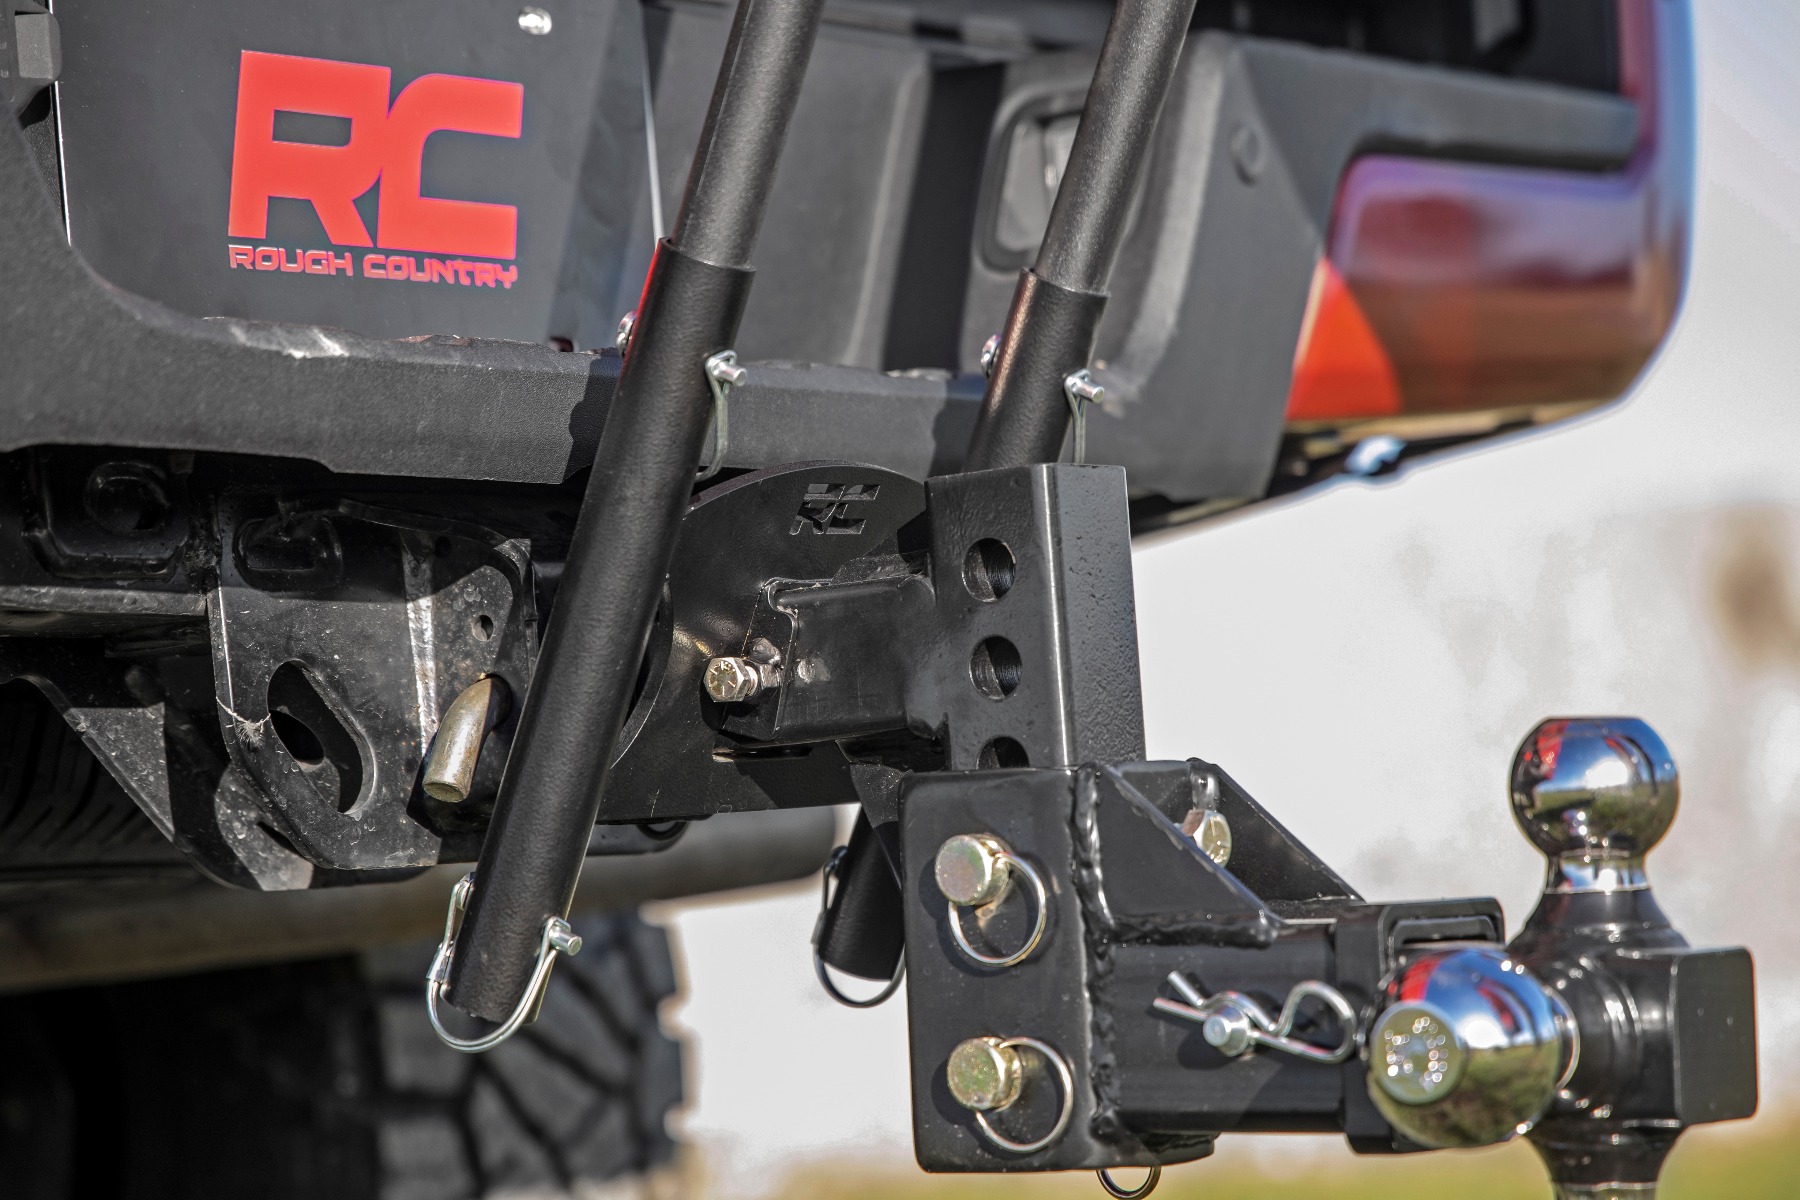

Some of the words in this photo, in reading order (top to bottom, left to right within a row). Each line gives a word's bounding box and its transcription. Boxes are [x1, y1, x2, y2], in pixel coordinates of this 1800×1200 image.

[228, 50, 524, 260] RC
[228, 245, 353, 276] ROUGH
[362, 254, 518, 289] COUNTRY
[789, 483, 880, 535] RC
